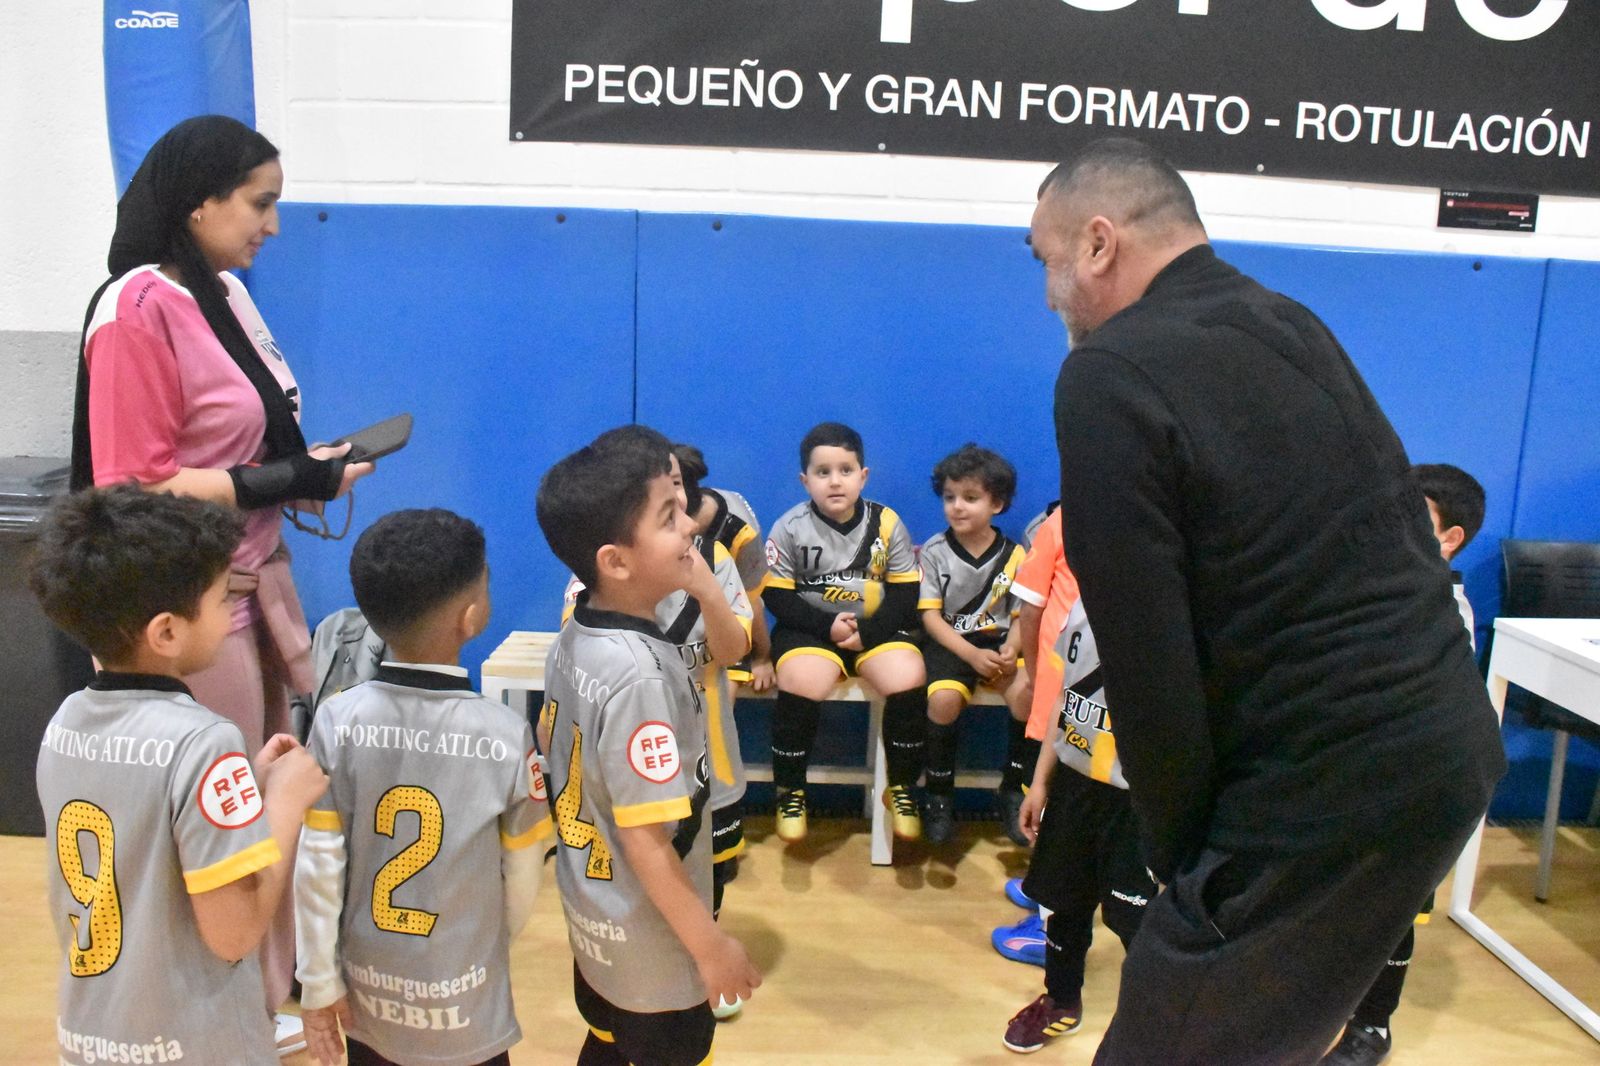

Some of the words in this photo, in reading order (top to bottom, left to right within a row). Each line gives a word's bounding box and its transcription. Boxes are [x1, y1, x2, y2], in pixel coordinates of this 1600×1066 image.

[115, 18, 179, 29] COADE
[564, 59, 804, 112] PEQUEÑO
[818, 72, 852, 111] Y
[865, 74, 1003, 119] GRAN
[1019, 82, 1250, 136] FORMATO
[1295, 101, 1590, 158] ROTULACIÓN
[801, 546, 823, 569] 17
[941, 574, 951, 598] 7
[1068, 631, 1082, 663] 6
[1063, 690, 1112, 733] EUT
[100, 735, 175, 768] ATLCO
[434, 733, 508, 761] ATLCO
[371, 785, 442, 937] 2
[57, 799, 123, 978] 9
